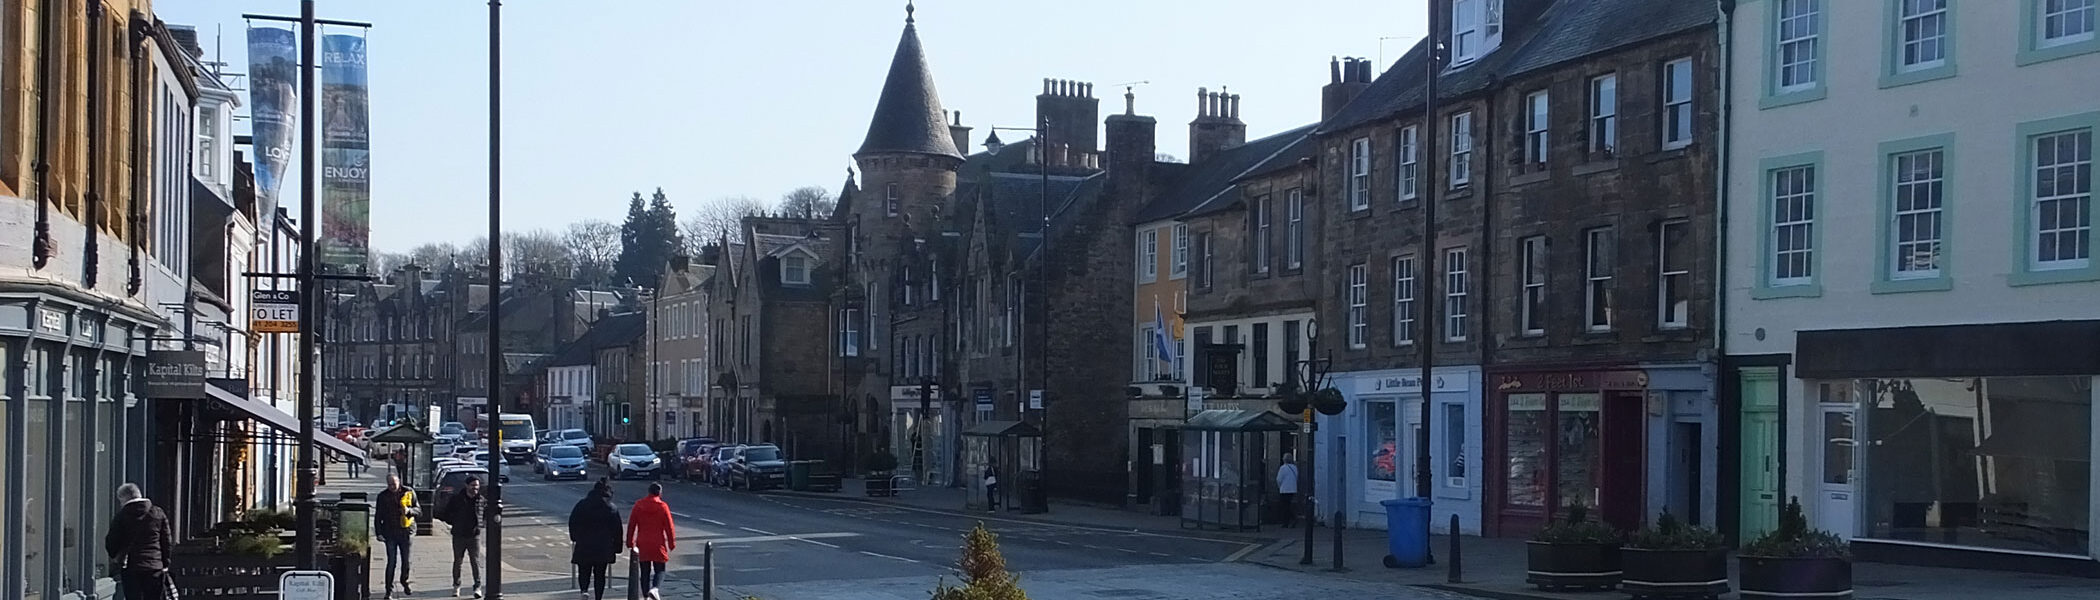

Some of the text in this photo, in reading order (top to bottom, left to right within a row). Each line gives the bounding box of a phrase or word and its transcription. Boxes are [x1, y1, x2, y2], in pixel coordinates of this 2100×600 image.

[324, 52, 366, 65] RELAX
[325, 166, 368, 179] ENJOY
[253, 291, 271, 300] Glen
[277, 292, 290, 300] Co
[252, 308, 294, 320] TO LET
[148, 363, 204, 378] Kapital Kilts
[1385, 377, 1400, 388] Little
